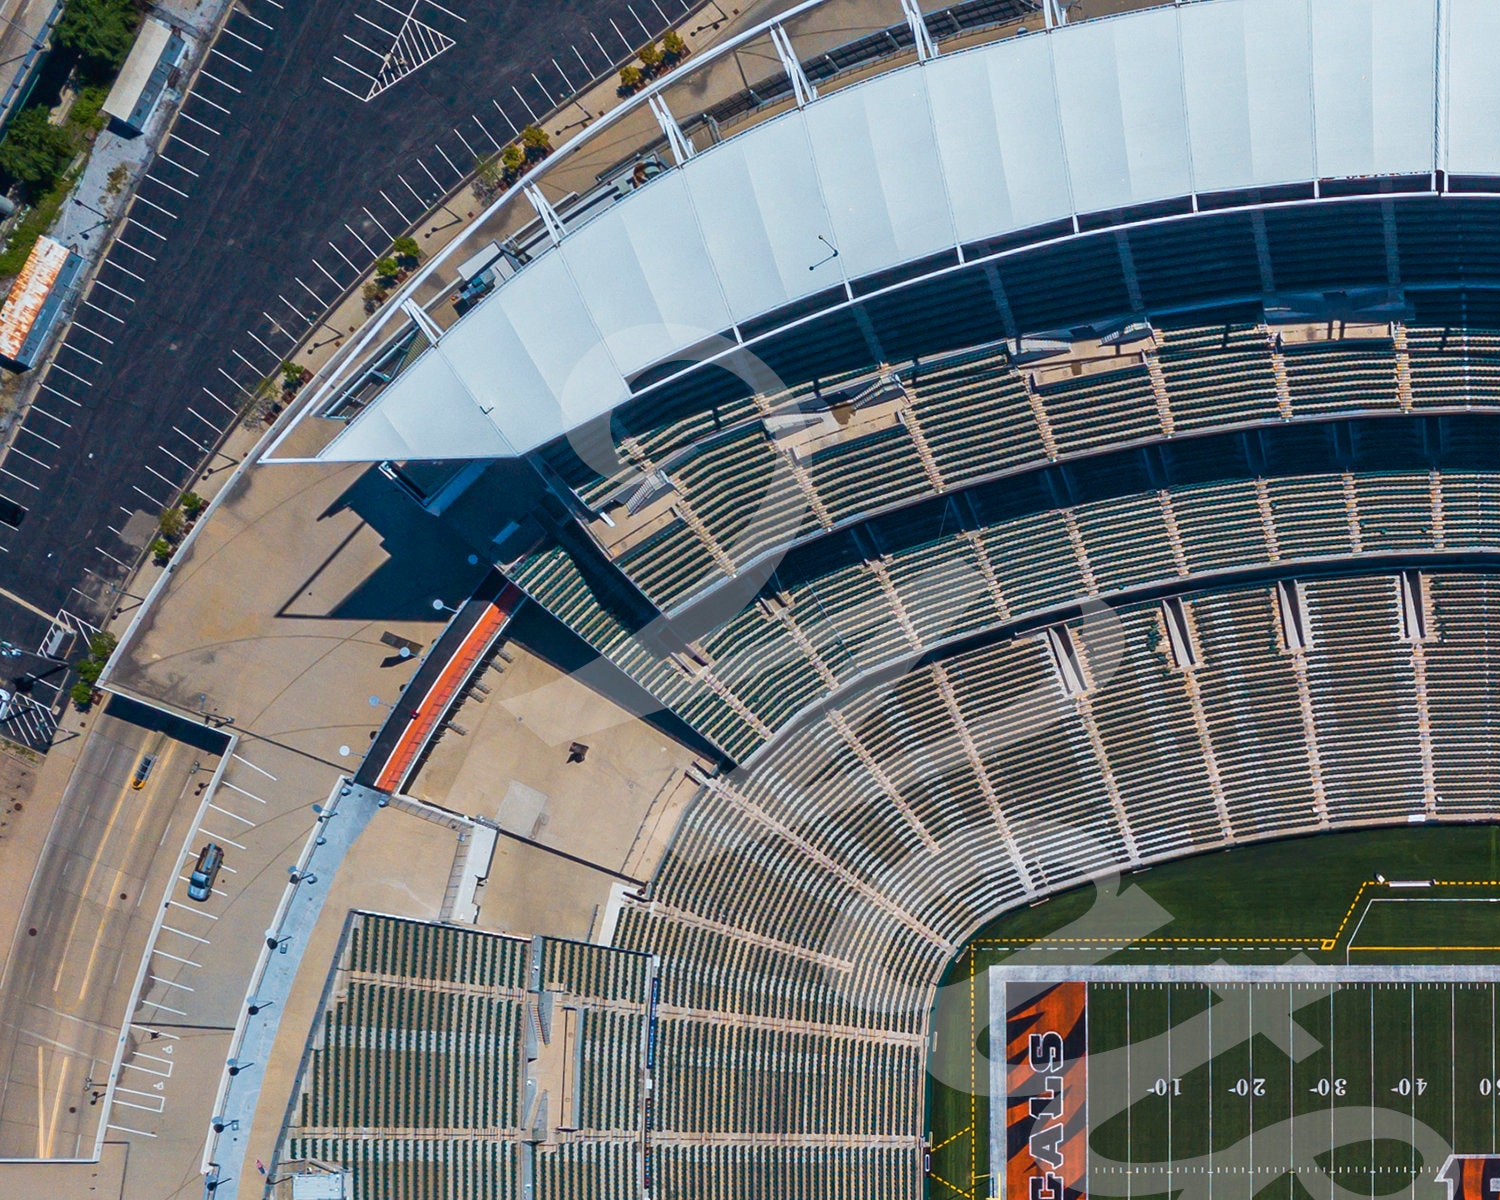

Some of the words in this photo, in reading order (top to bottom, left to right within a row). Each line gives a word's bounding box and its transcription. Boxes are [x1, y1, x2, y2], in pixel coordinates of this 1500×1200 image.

[1154, 1077, 1182, 1096] 10
[1236, 1077, 1266, 1096] 20
[1317, 1077, 1347, 1096] 30
[1398, 1077, 1428, 1096] 40
